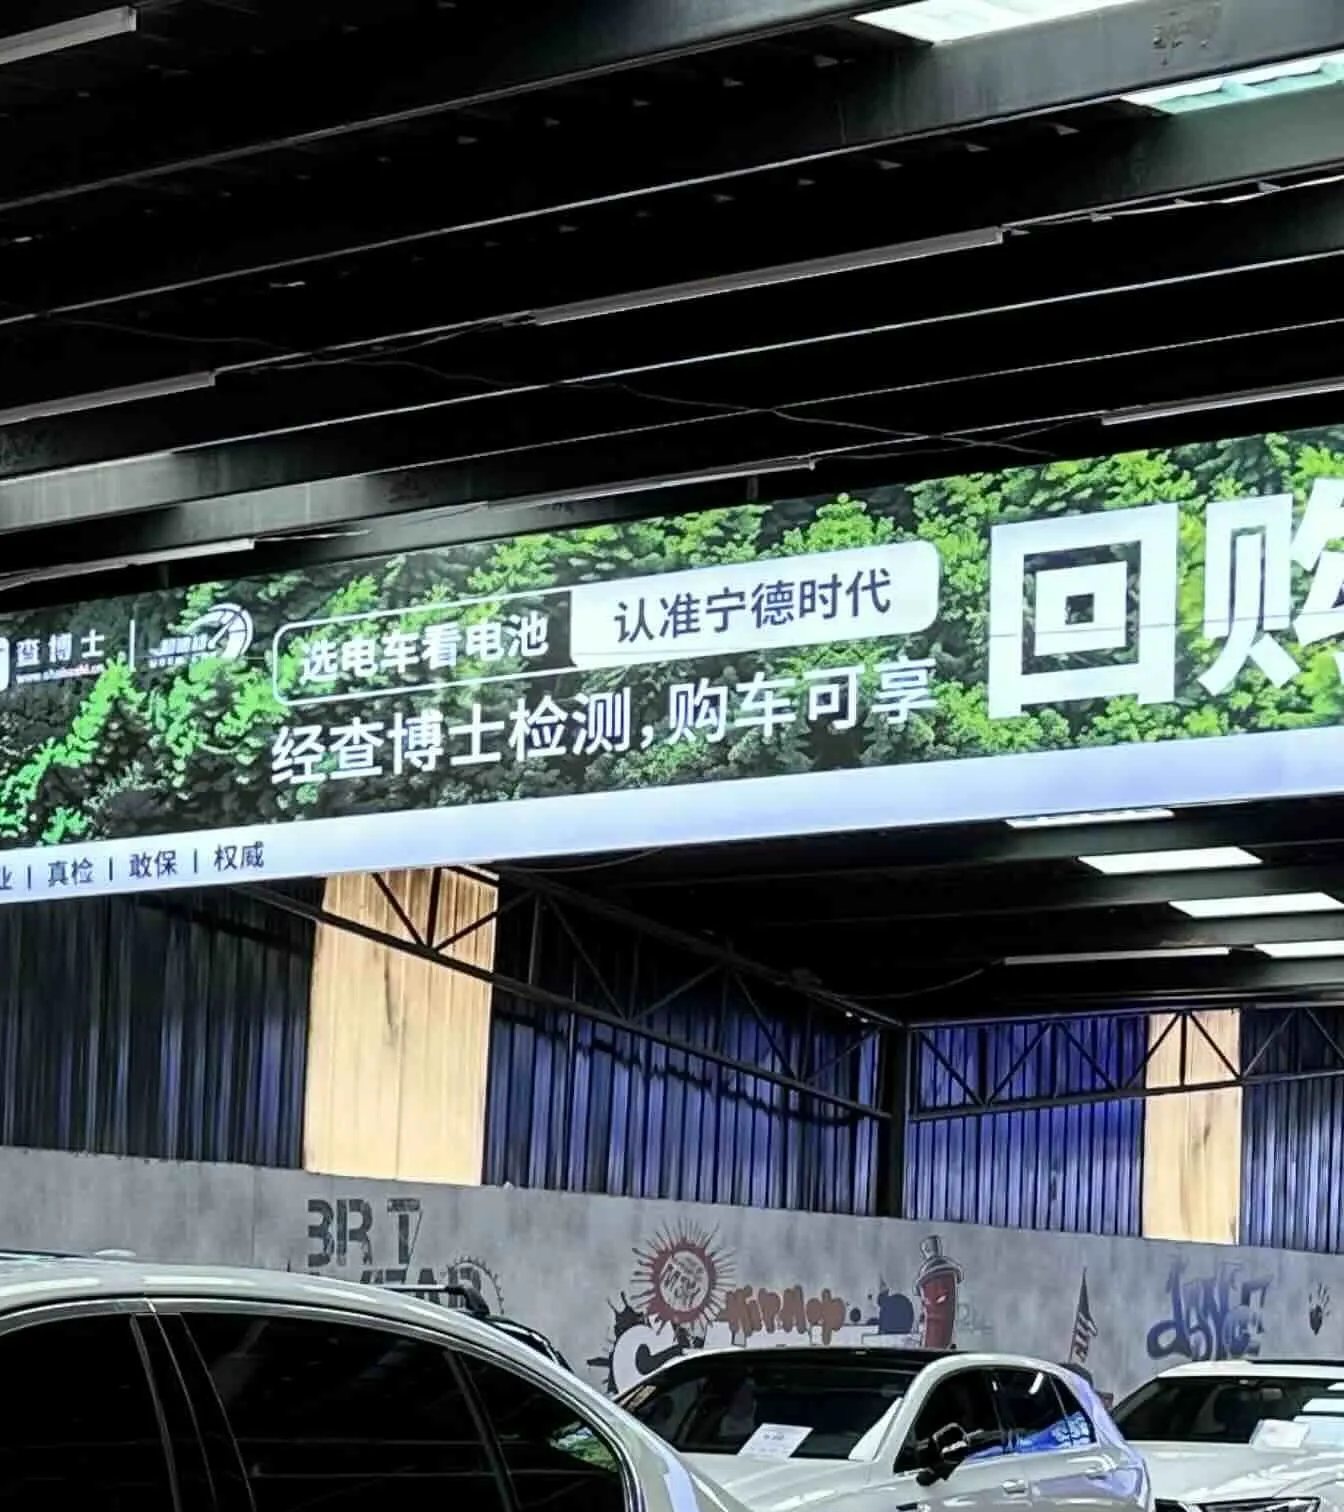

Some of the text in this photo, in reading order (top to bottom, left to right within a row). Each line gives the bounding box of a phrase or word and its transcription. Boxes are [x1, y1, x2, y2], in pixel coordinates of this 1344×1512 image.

[16, 629, 105, 667] 查博士
[300, 611, 549, 685] 选电车看电池
[614, 568, 891, 643] 认准宁德时代
[47, 858, 94, 887] 真检
[129, 850, 178, 880] 敢保
[214, 841, 265, 871] 权威
